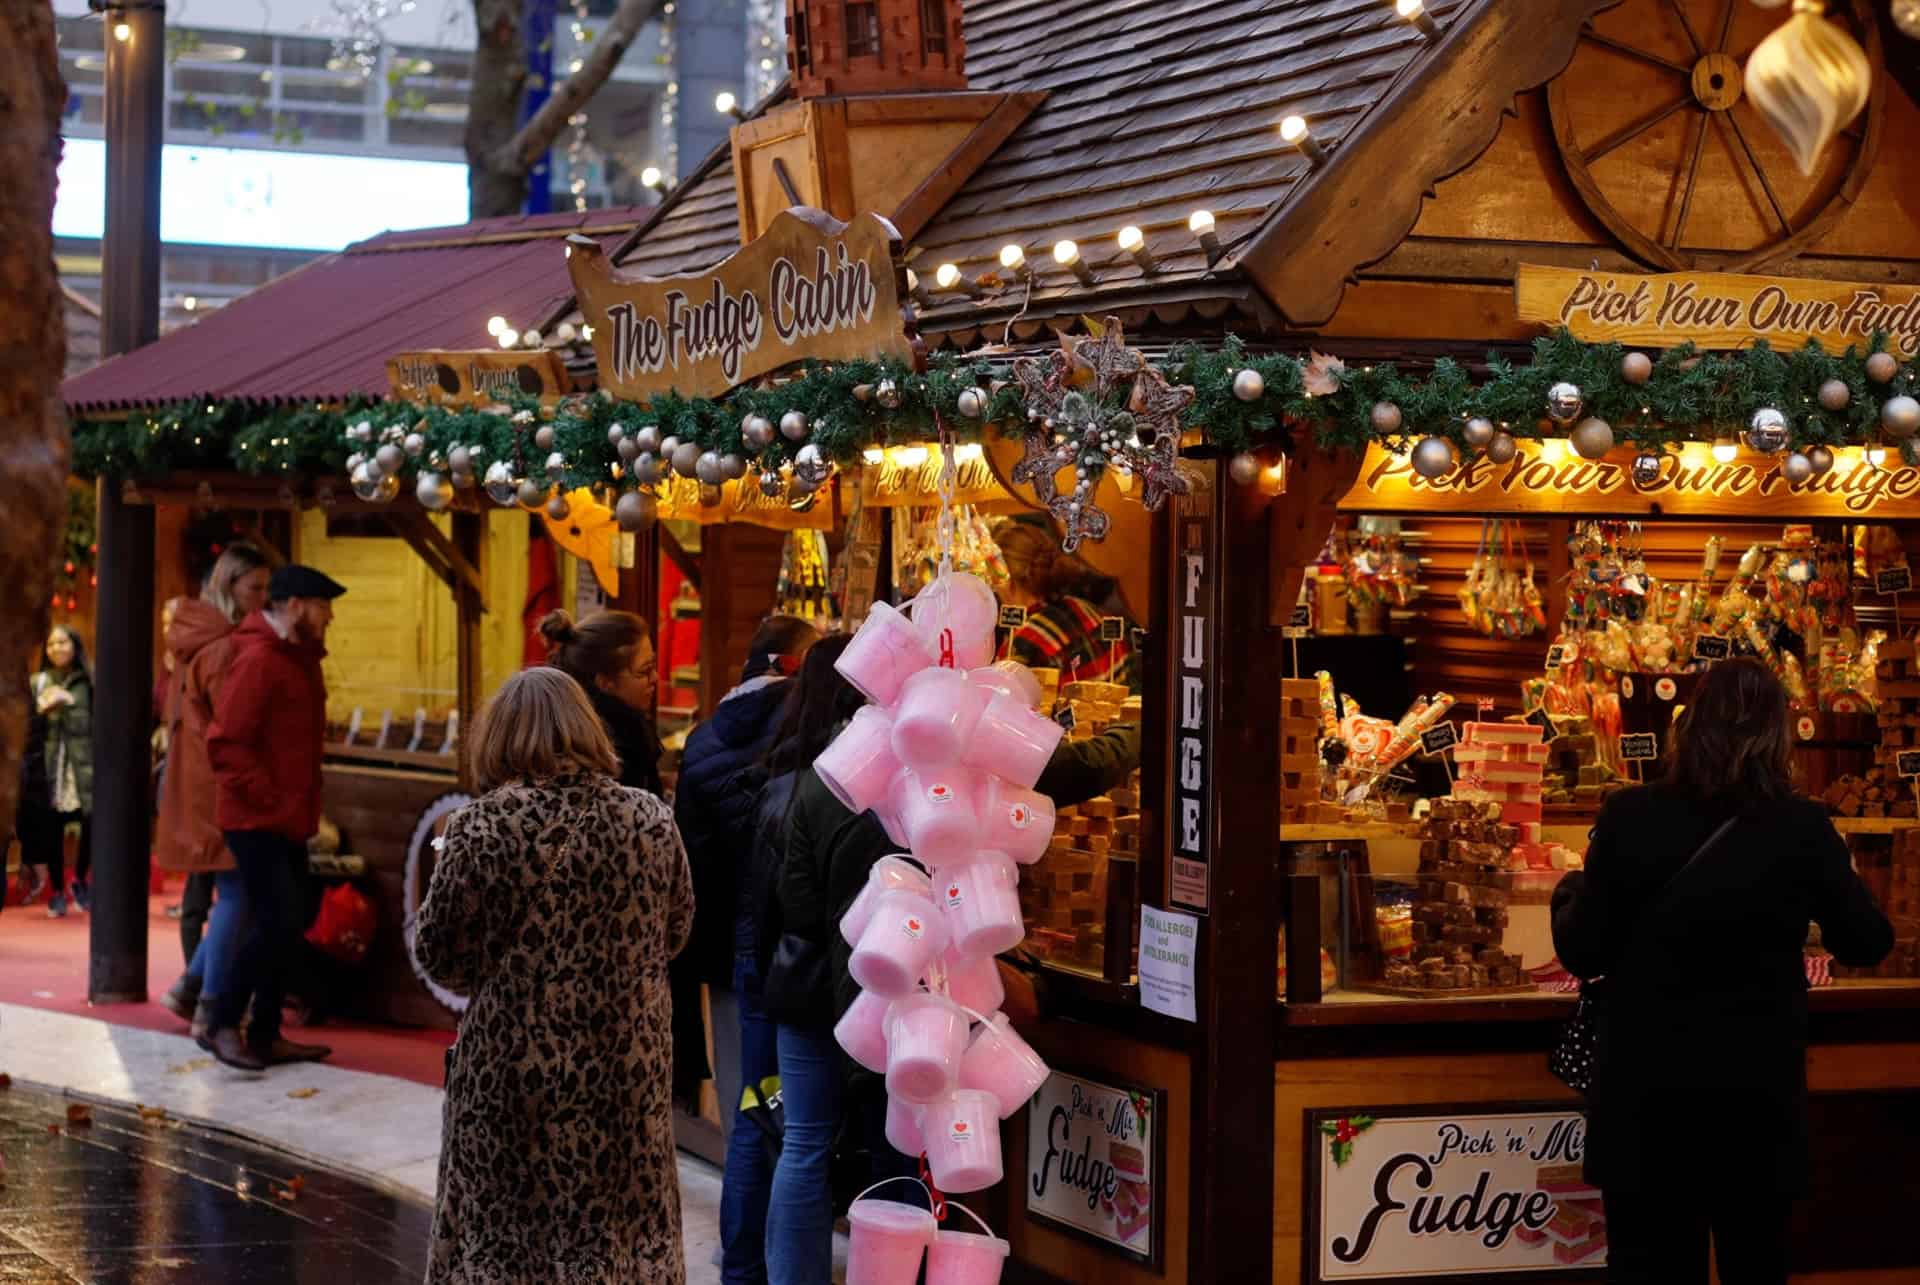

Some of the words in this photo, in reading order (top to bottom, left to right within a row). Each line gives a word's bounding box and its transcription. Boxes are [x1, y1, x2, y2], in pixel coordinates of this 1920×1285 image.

[608, 301, 665, 384] The
[664, 276, 762, 387] Fudge
[769, 240, 876, 346] Cabin
[1560, 276, 1651, 324] Pick
[1655, 281, 1742, 328] Your
[1747, 284, 1837, 334] Own
[1366, 448, 1498, 495] Pck
[1500, 450, 1626, 495] Your
[1631, 453, 1757, 496] Own
[1181, 549, 1205, 853] FUDGE
[1032, 1105, 1119, 1211] Fudge
[1106, 1098, 1135, 1141] Mix
[1428, 1123, 1497, 1165] Pick
[1505, 1127, 1536, 1153] 'n'
[1529, 1117, 1585, 1163] Mi
[1331, 1152, 1559, 1263] Fudge
